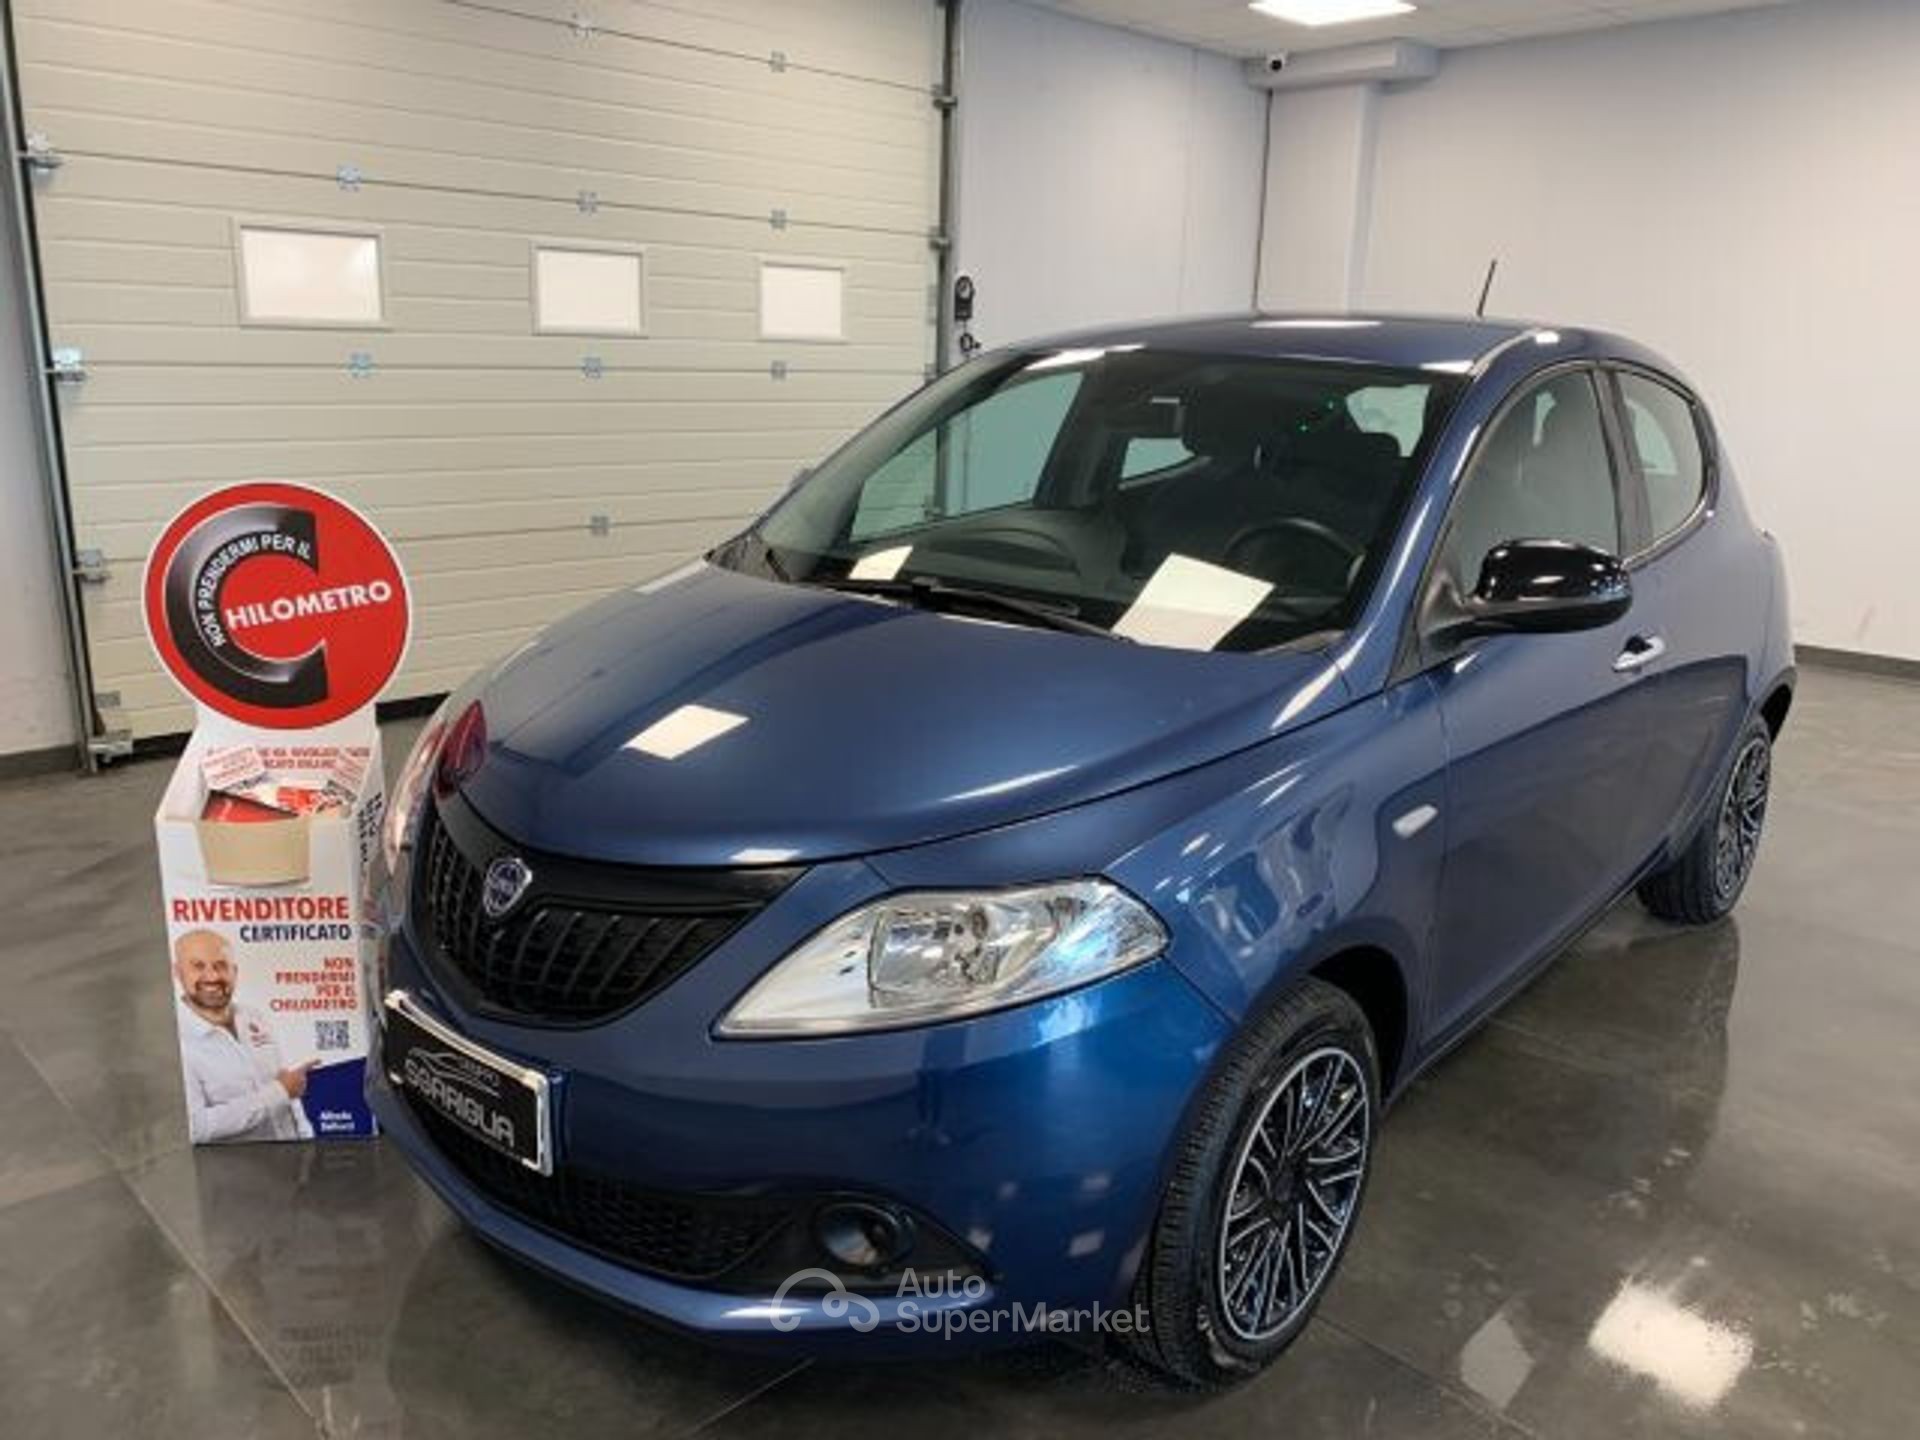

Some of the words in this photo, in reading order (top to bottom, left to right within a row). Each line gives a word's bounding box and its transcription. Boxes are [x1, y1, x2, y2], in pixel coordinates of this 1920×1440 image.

[261, 534, 296, 553] PER
[297, 541, 311, 560] IL
[198, 537, 259, 610] PRENDERMI
[201, 612, 227, 647] NON
[173, 898, 349, 922] RIVENDITORE
[240, 924, 351, 942] CERTIFICATO
[324, 957, 354, 970] NON
[276, 971, 355, 984] PRENDERMI
